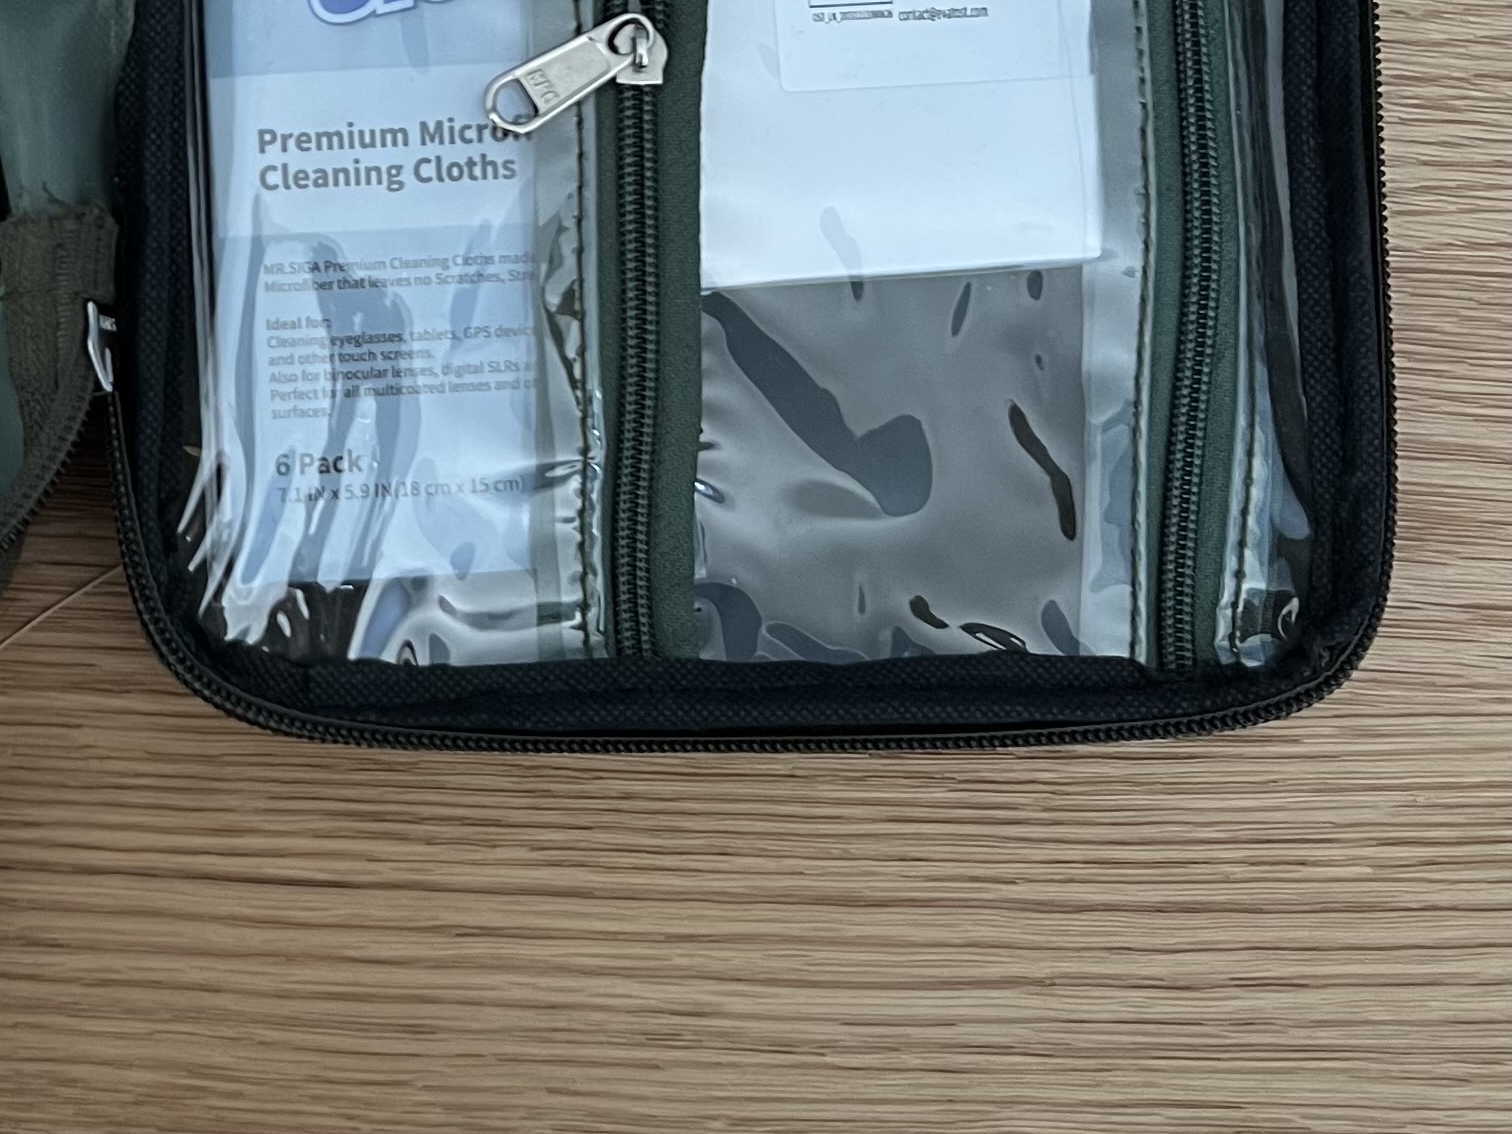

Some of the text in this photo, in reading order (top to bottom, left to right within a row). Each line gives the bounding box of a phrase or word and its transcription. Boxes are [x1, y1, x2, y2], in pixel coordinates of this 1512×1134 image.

[257, 121, 410, 155] Premium
[258, 154, 517, 193] Cleaning Cloths
[324, 259, 386, 272] Premium
[390, 255, 450, 270] Cleaning
[452, 254, 495, 267] Cloths
[337, 277, 366, 290] that
[367, 275, 412, 290] leaves
[414, 276, 432, 287] no
[435, 270, 506, 286] Scratches,
[266, 316, 302, 331] Ideal
[267, 335, 329, 349] Cleaning
[463, 325, 492, 339] GPS
[268, 353, 295, 367] and
[298, 352, 335, 365] other
[338, 349, 378, 364] touch
[269, 370, 298, 384] Also
[301, 369, 321, 383] for
[324, 367, 389, 382] binocular
[441, 361, 485, 379] digital
[487, 360, 520, 373] SLRs
[270, 388, 319, 402] Perfect
[322, 387, 337, 399] for
[343, 385, 361, 399] all
[363, 382, 446, 397] multicoated
[449, 381, 492, 394] lenses
[494, 377, 520, 391] and
[275, 448, 364, 477] 6 Pack
[344, 483, 370, 500] 5.9
[425, 482, 451, 498] cm
[455, 482, 465, 494] x
[470, 477, 490, 494] 15
[492, 474, 527, 493] cm)
